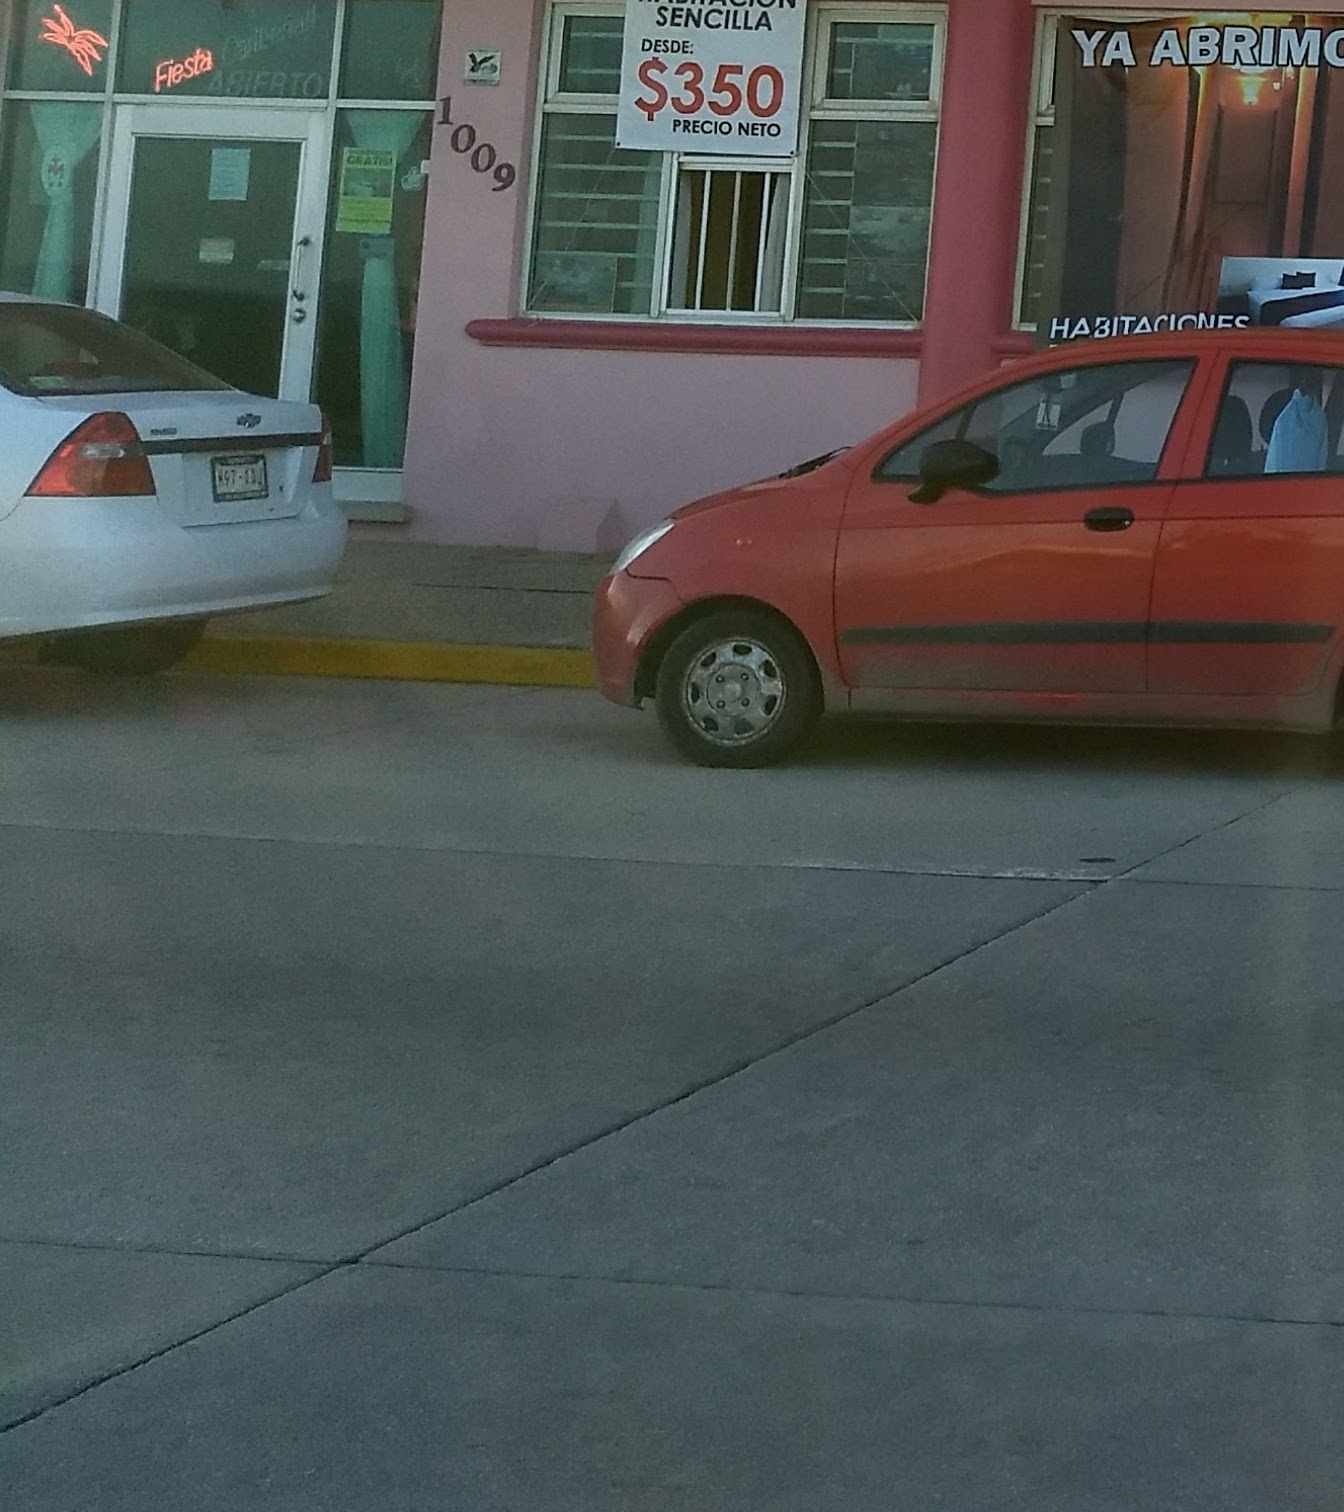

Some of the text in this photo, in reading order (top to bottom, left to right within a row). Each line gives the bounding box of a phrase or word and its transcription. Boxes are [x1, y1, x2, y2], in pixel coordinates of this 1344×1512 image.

[655, 6, 773, 31] SENCILLA
[641, 38, 694, 55] DESDE:
[1071, 29, 1136, 68] YA
[154, 48, 214, 93] Fiesta
[634, 56, 785, 122] $350
[437, 96, 516, 192] 1009
[672, 119, 782, 137] PRECIO NETO
